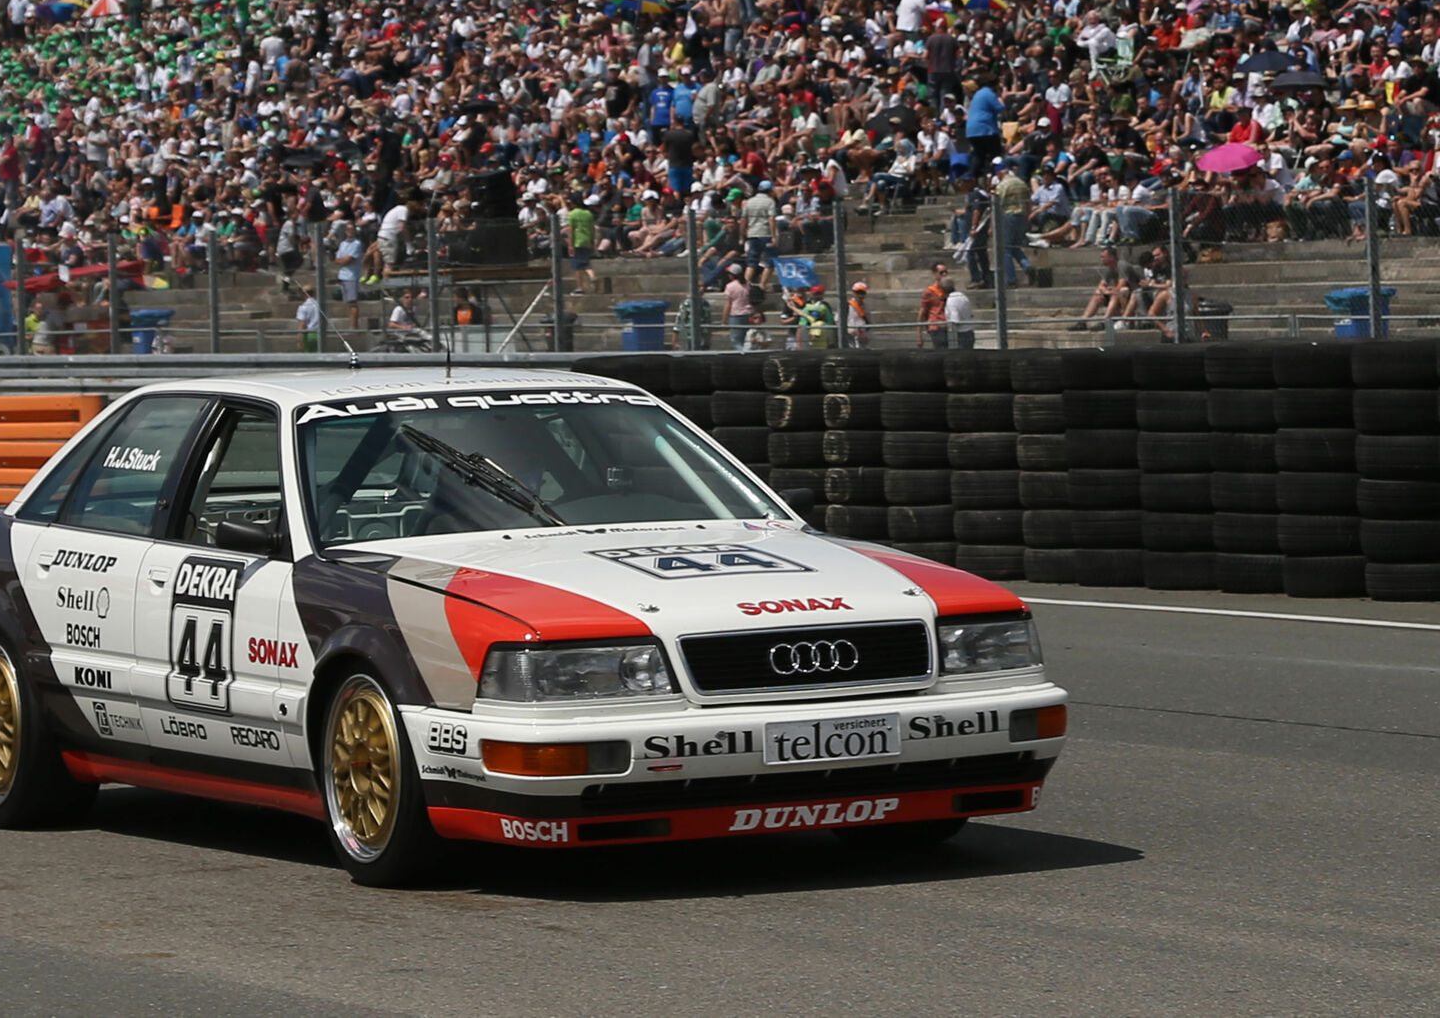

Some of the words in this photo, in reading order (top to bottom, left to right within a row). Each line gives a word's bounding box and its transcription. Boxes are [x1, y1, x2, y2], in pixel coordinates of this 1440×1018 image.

[296, 397, 438, 425] Audi
[446, 390, 660, 410] quattro
[52, 549, 118, 573] DUNLOP
[595, 544, 748, 558] DEKRA
[655, 553, 782, 571] 44
[175, 563, 238, 601] DEKRA
[56, 586, 95, 612] Shell
[737, 597, 854, 616] SONAX
[66, 623, 101, 649] BOSCH
[177, 615, 228, 700] 44
[248, 637, 299, 668] SONAX
[74, 666, 112, 689] KONI
[160, 716, 208, 740] LÖBRO
[834, 717, 888, 731] versichert
[908, 711, 1000, 740] Shell
[230, 726, 280, 751] RECARO
[428, 721, 468, 755] BBS
[644, 730, 754, 760] Shell
[774, 722, 890, 762] telcon
[728, 798, 899, 831] DUNLOP
[499, 817, 568, 844] BOSCH
